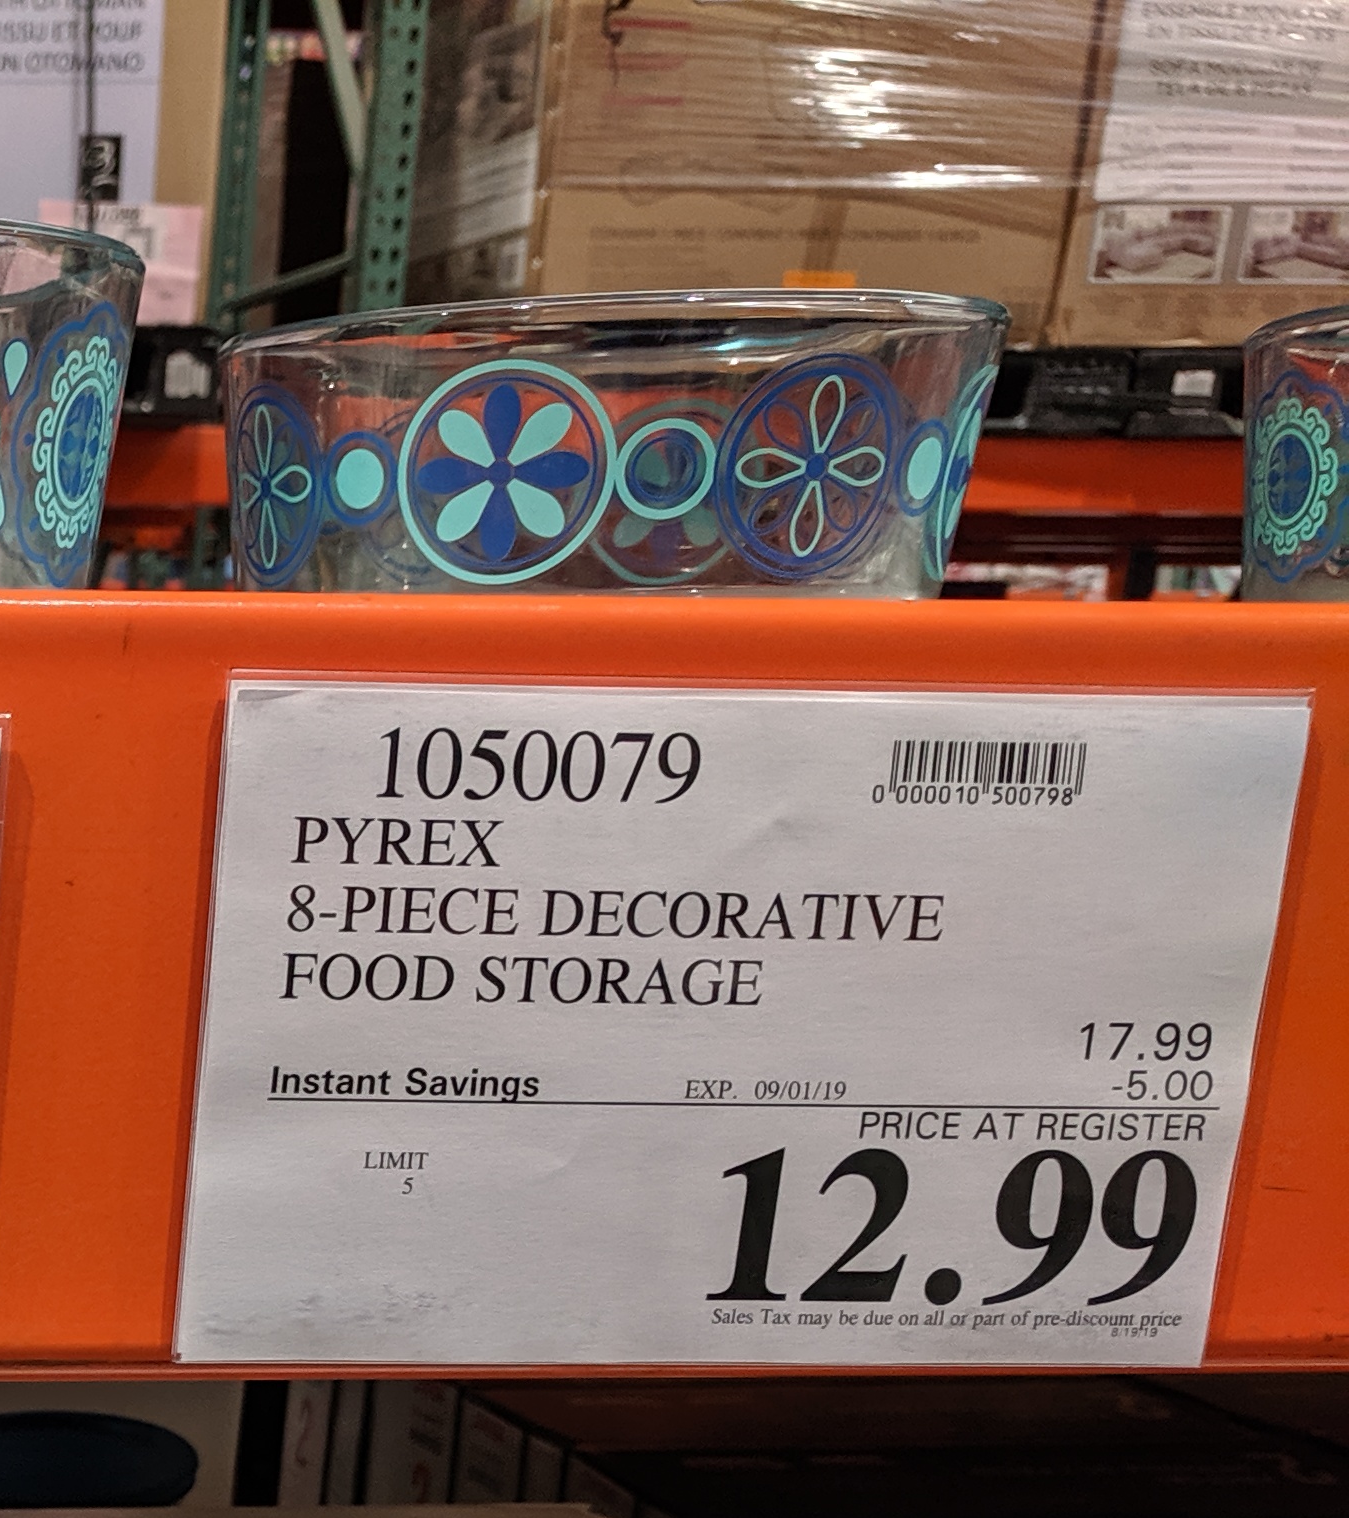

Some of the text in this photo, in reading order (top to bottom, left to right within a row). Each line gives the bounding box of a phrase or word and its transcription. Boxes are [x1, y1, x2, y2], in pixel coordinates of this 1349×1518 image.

[376, 728, 701, 805] 1050079
[290, 816, 505, 868] PYREX
[287, 885, 945, 944] 8-PIECE DECORATIVE
[277, 953, 765, 1009] FOOD STORAGE
[1077, 1021, 1215, 1064] 17.99
[269, 1067, 848, 1105] Instant Savings EXP. 09/01/19
[1110, 1069, 1215, 1104] -5.00
[857, 1110, 1207, 1144] PRICE AT REGISTER
[363, 1151, 430, 1172] LIMIT
[400, 1177, 415, 1196] 5
[704, 1145, 1200, 1308] 12.99
[711, 1309, 1183, 1331] Sales Tax may be due on all or part of pre-discount price
